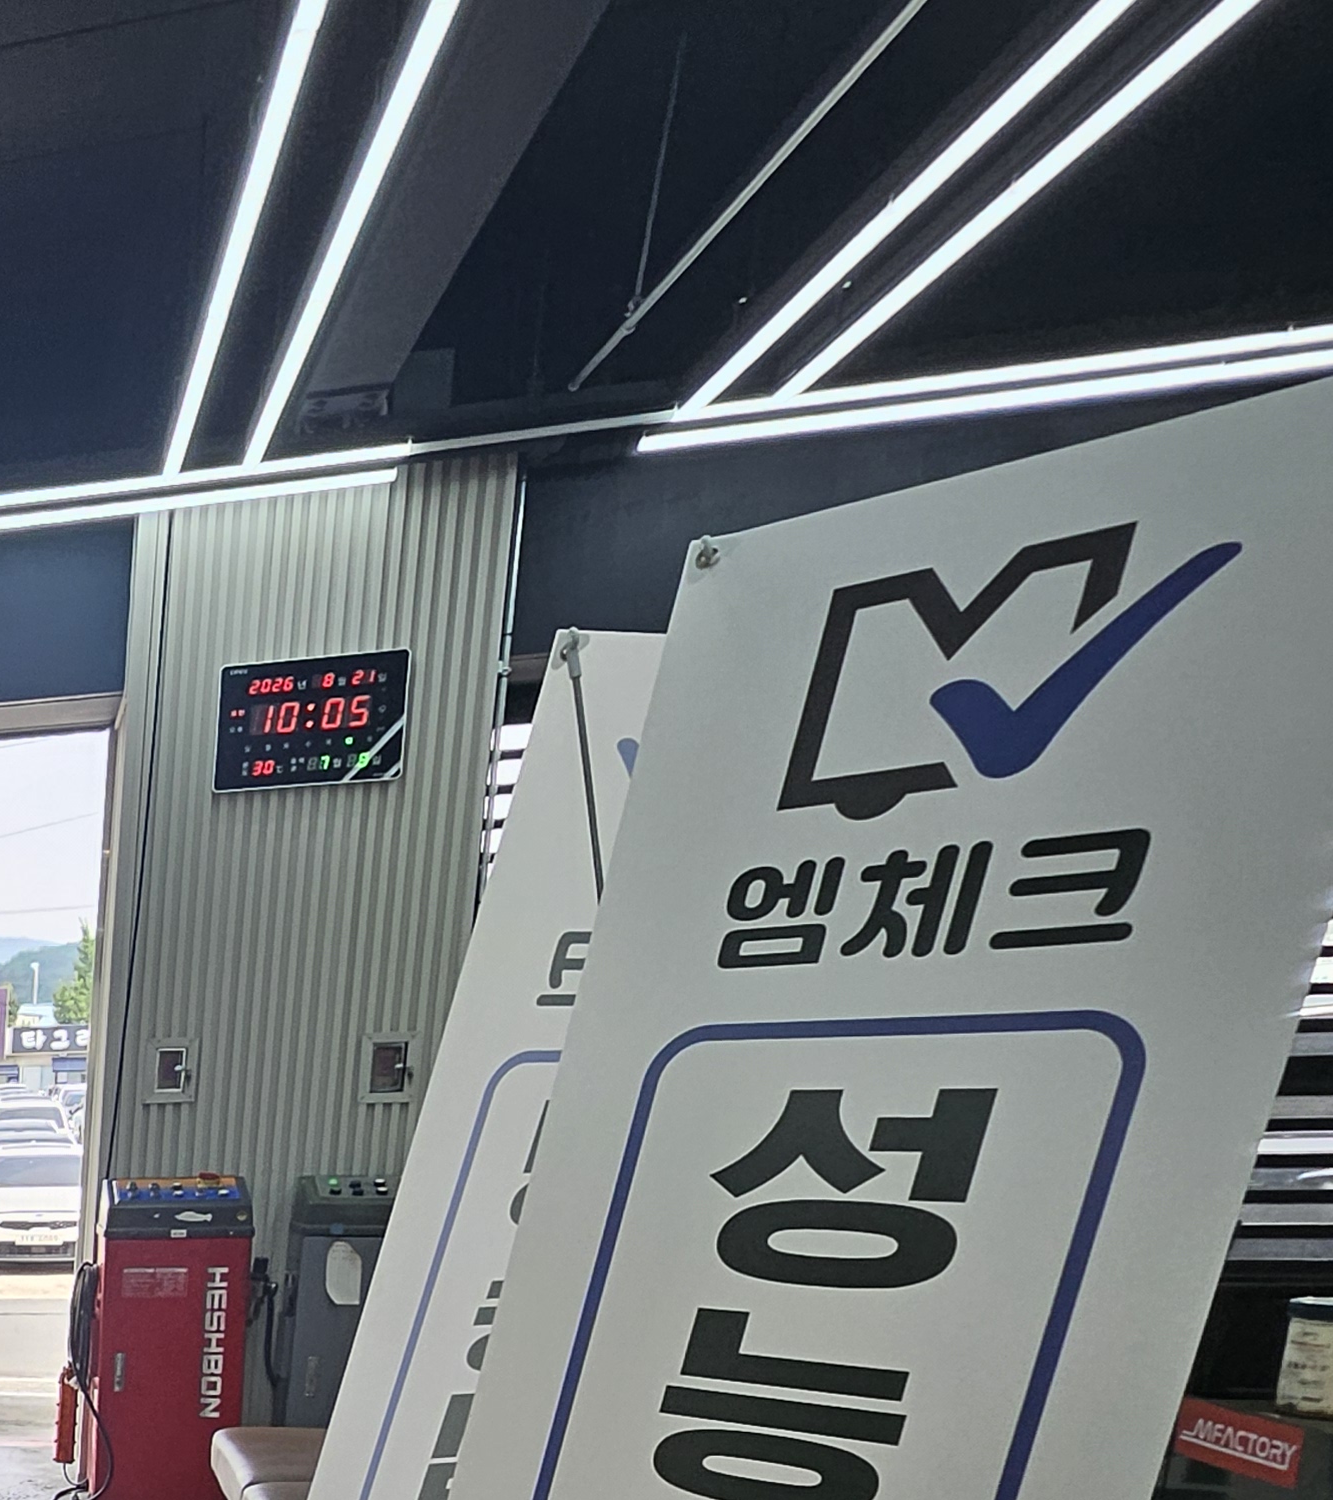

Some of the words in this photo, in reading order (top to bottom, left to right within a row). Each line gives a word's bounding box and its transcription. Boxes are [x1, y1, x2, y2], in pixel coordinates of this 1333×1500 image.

[248, 676, 295, 695] 2026
[321, 672, 335, 688] 8
[351, 669, 377, 685] 21
[264, 695, 371, 734] 10:05
[252, 760, 275, 776] 30
[717, 828, 1151, 969] 엠체크
[199, 1266, 229, 1419] HESHBON
[1183, 1418, 1297, 1470] MFACTORY
